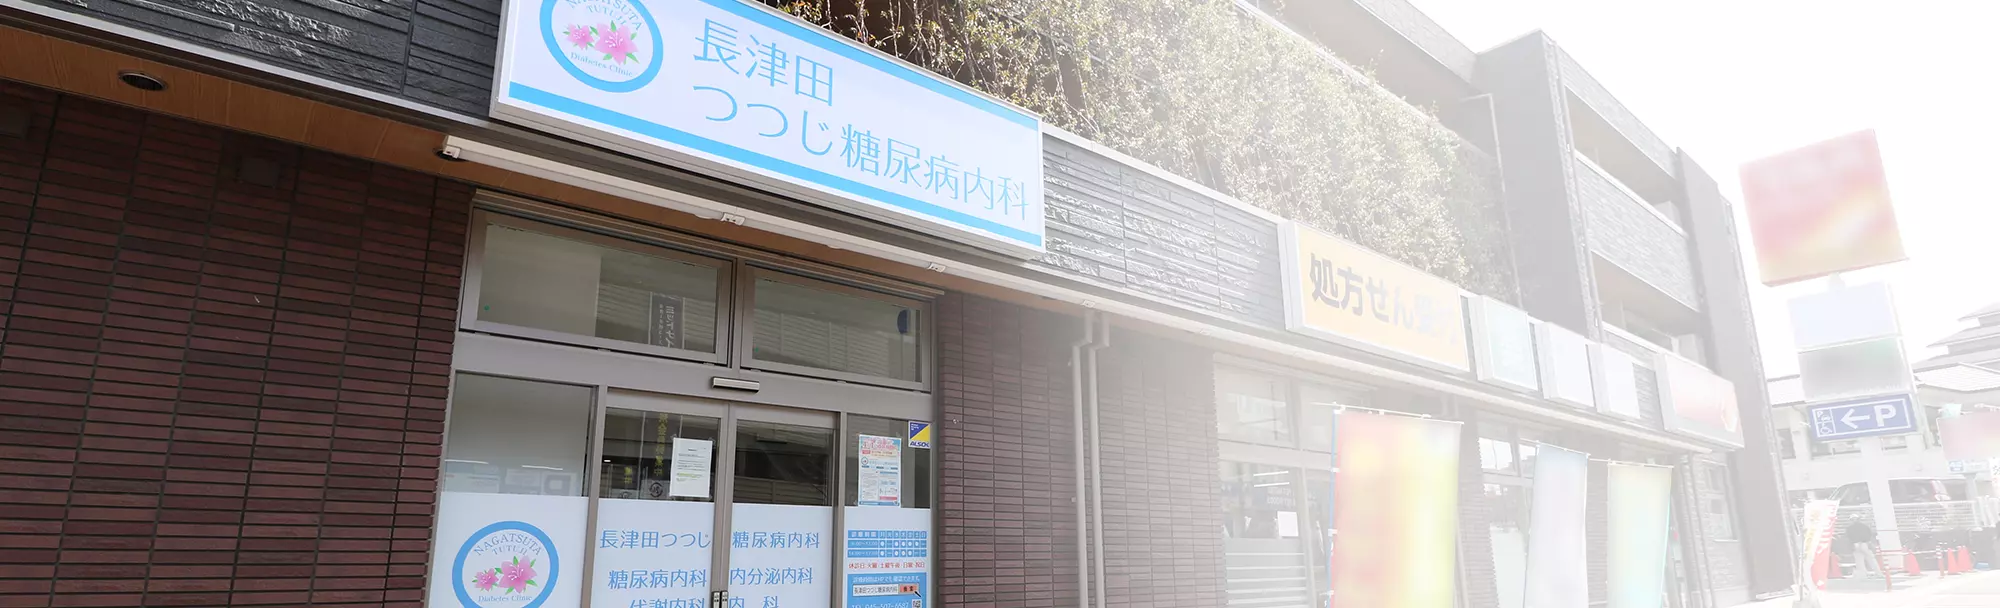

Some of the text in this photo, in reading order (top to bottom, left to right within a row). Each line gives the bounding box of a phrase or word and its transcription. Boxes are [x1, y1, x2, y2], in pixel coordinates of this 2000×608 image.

[570, 52, 633, 78] Diabetes Clinic
[693, 18, 834, 107] 長津田
[1873, 404, 1897, 427] P
[473, 532, 542, 557] NAGATSUTA
[491, 544, 528, 556] TUTUJI
[599, 529, 821, 549] 長津田つつじ 糖尿病内科
[607, 567, 814, 590] 糖尿病内科 内分泌内科
[477, 594, 533, 603] Diabetes Clinic
